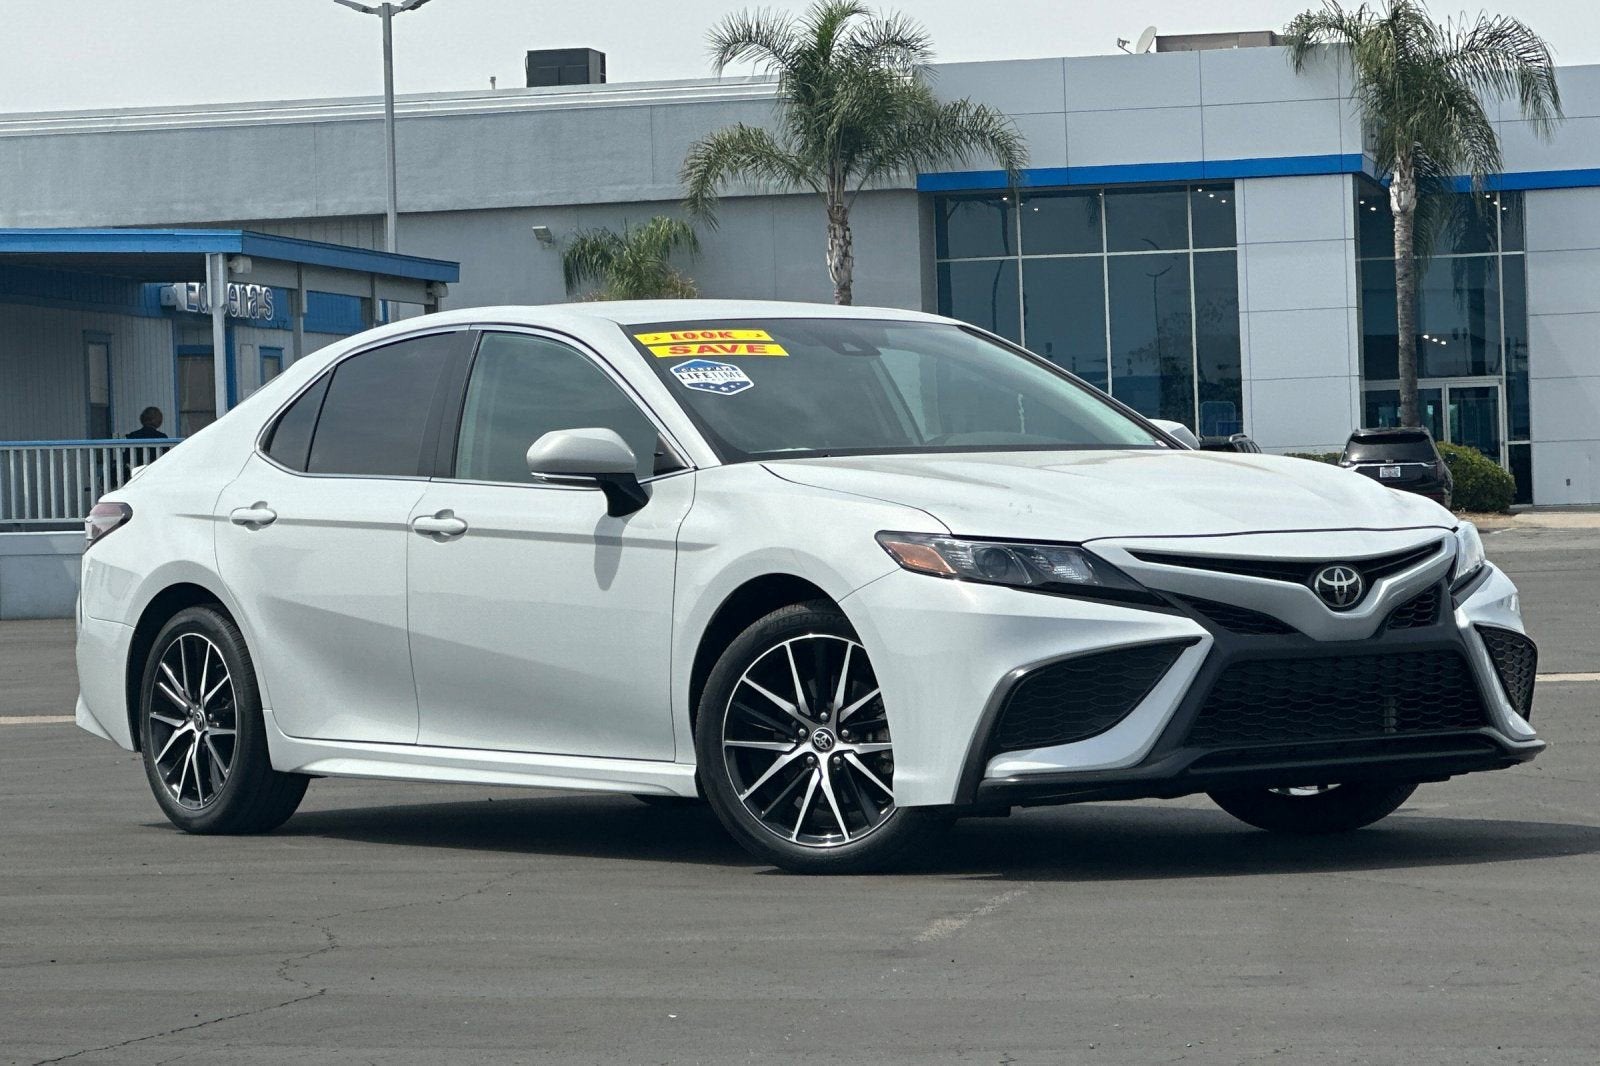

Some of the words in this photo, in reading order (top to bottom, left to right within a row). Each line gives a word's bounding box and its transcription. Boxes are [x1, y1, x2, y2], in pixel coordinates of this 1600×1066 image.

[670, 330, 734, 341] LOOK
[669, 344, 768, 355] SAVE
[678, 371, 745, 380] LIFETIME
